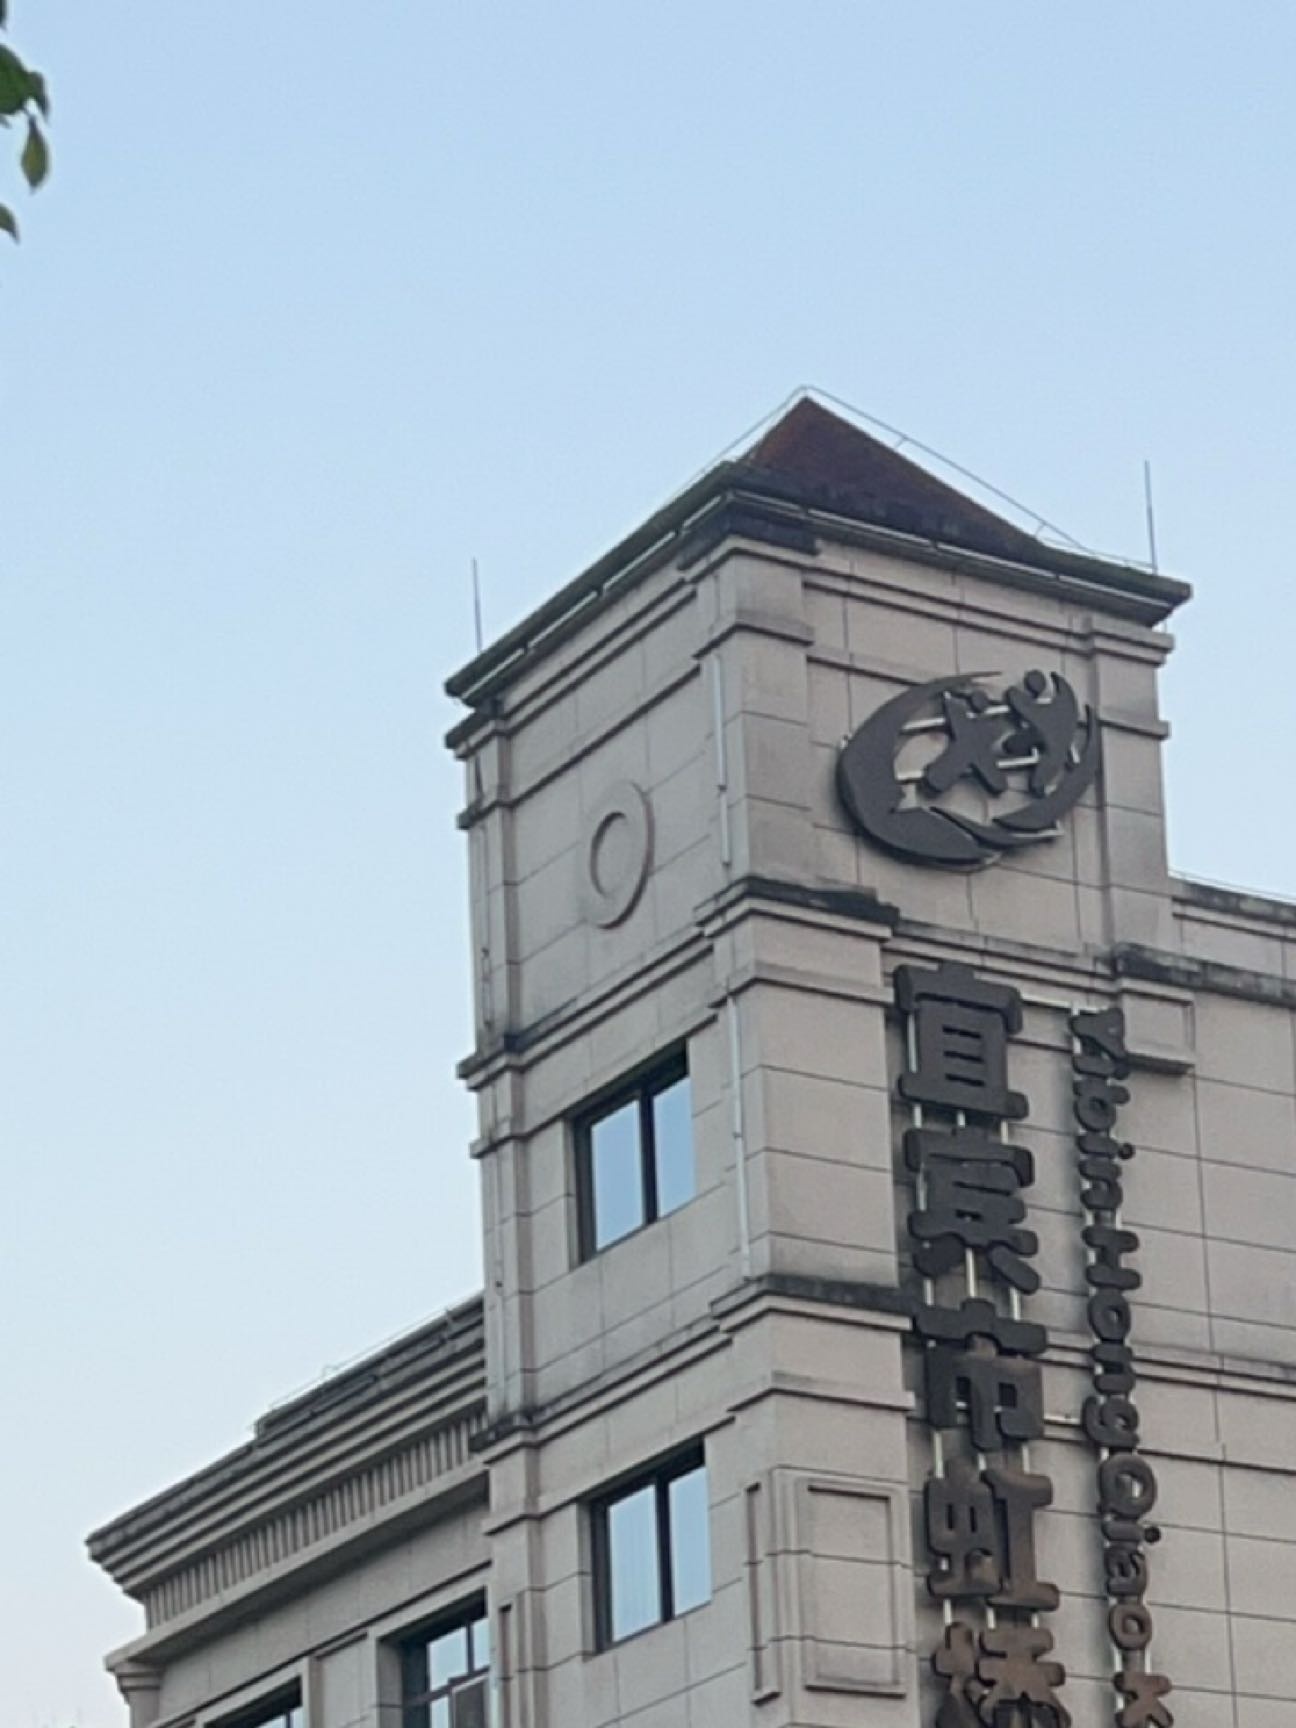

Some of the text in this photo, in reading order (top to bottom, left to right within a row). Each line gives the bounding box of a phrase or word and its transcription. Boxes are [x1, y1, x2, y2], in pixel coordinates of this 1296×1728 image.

[1069, 1006, 1136, 1211] Yibin
[1082, 1225, 1141, 1452] Hong
[1099, 1454, 1161, 1650] Qiao
